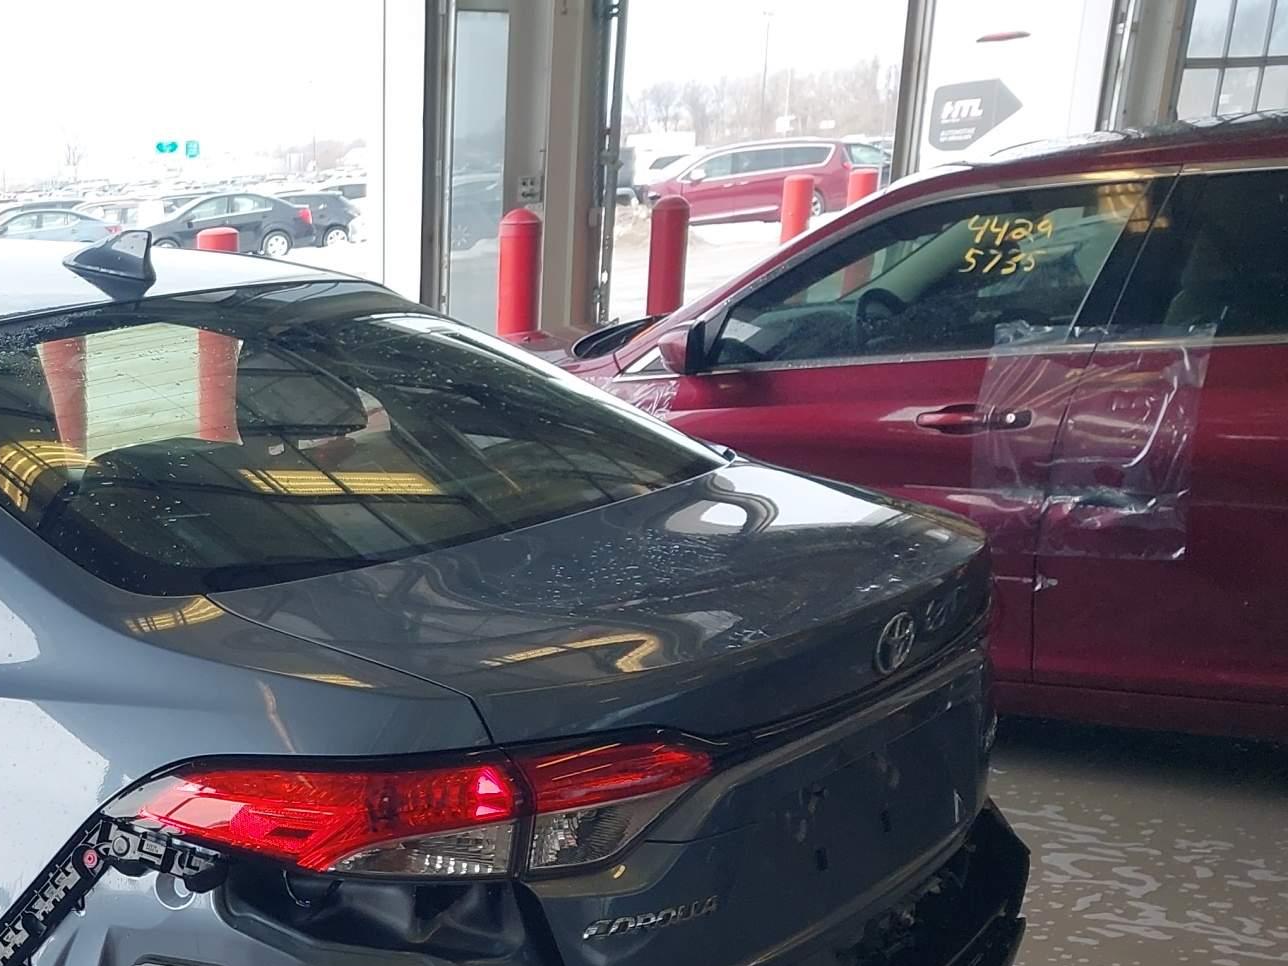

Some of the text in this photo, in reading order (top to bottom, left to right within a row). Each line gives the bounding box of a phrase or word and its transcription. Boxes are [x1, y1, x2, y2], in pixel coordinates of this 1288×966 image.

[967, 214, 1054, 246] 4429
[958, 247, 1047, 275] 5735
[582, 895, 720, 940] COROLLA
